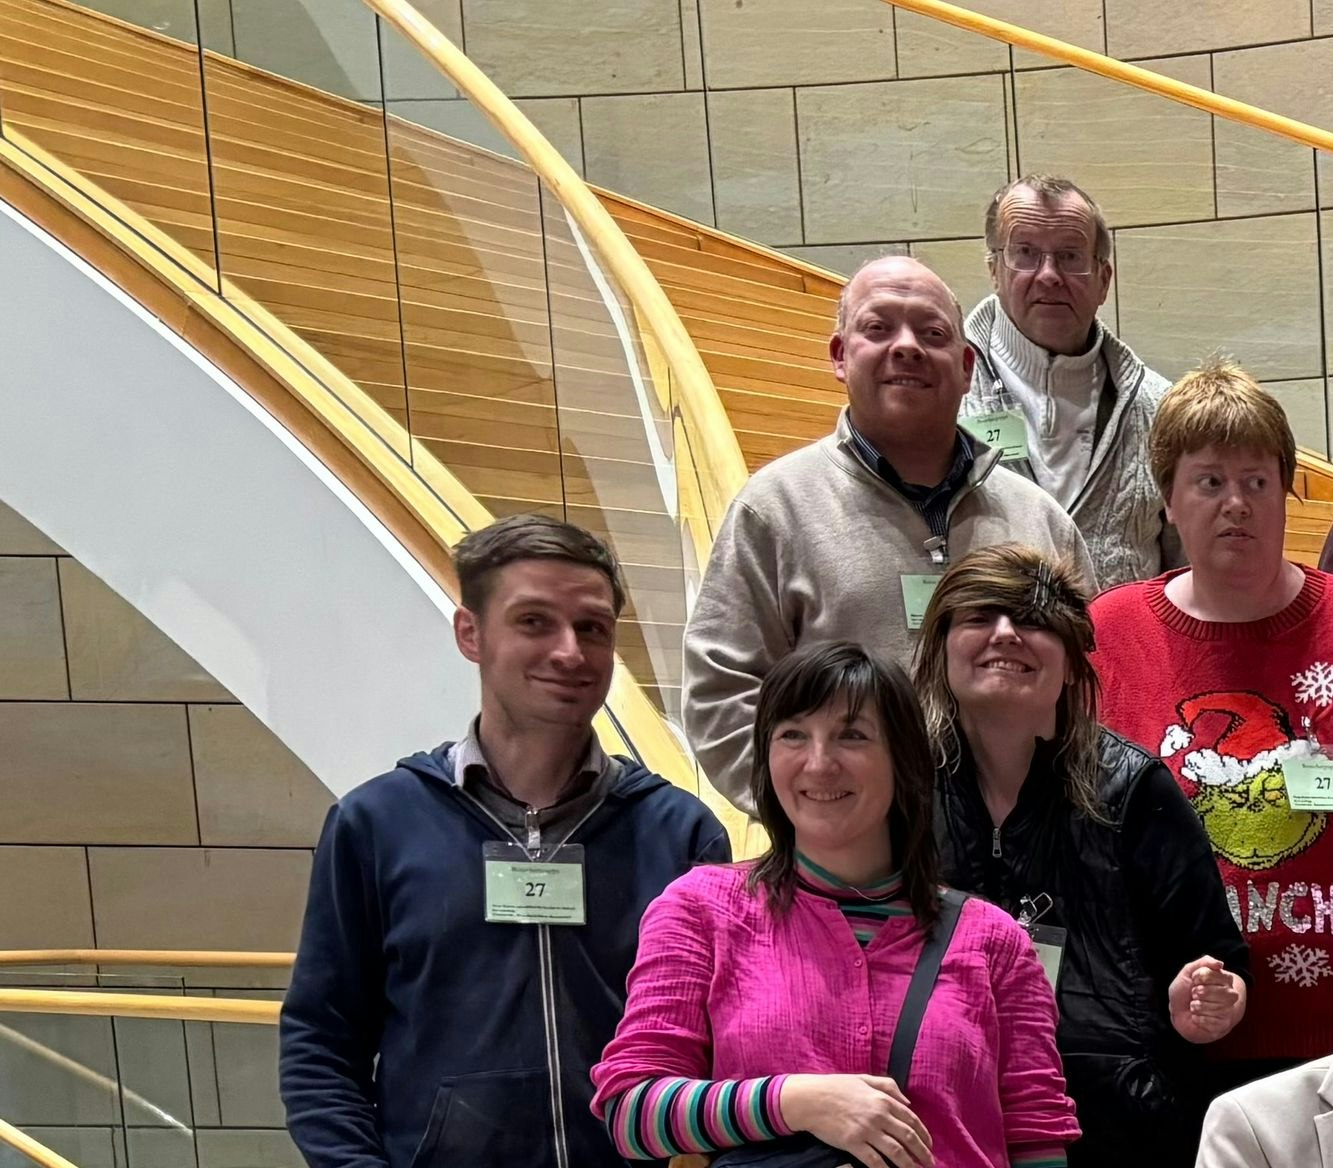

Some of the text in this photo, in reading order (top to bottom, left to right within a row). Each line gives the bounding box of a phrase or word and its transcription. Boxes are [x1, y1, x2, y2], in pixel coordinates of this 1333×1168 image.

[985, 428, 1001, 443] 27
[1314, 776, 1331, 790] 27
[525, 882, 546, 897] 27
